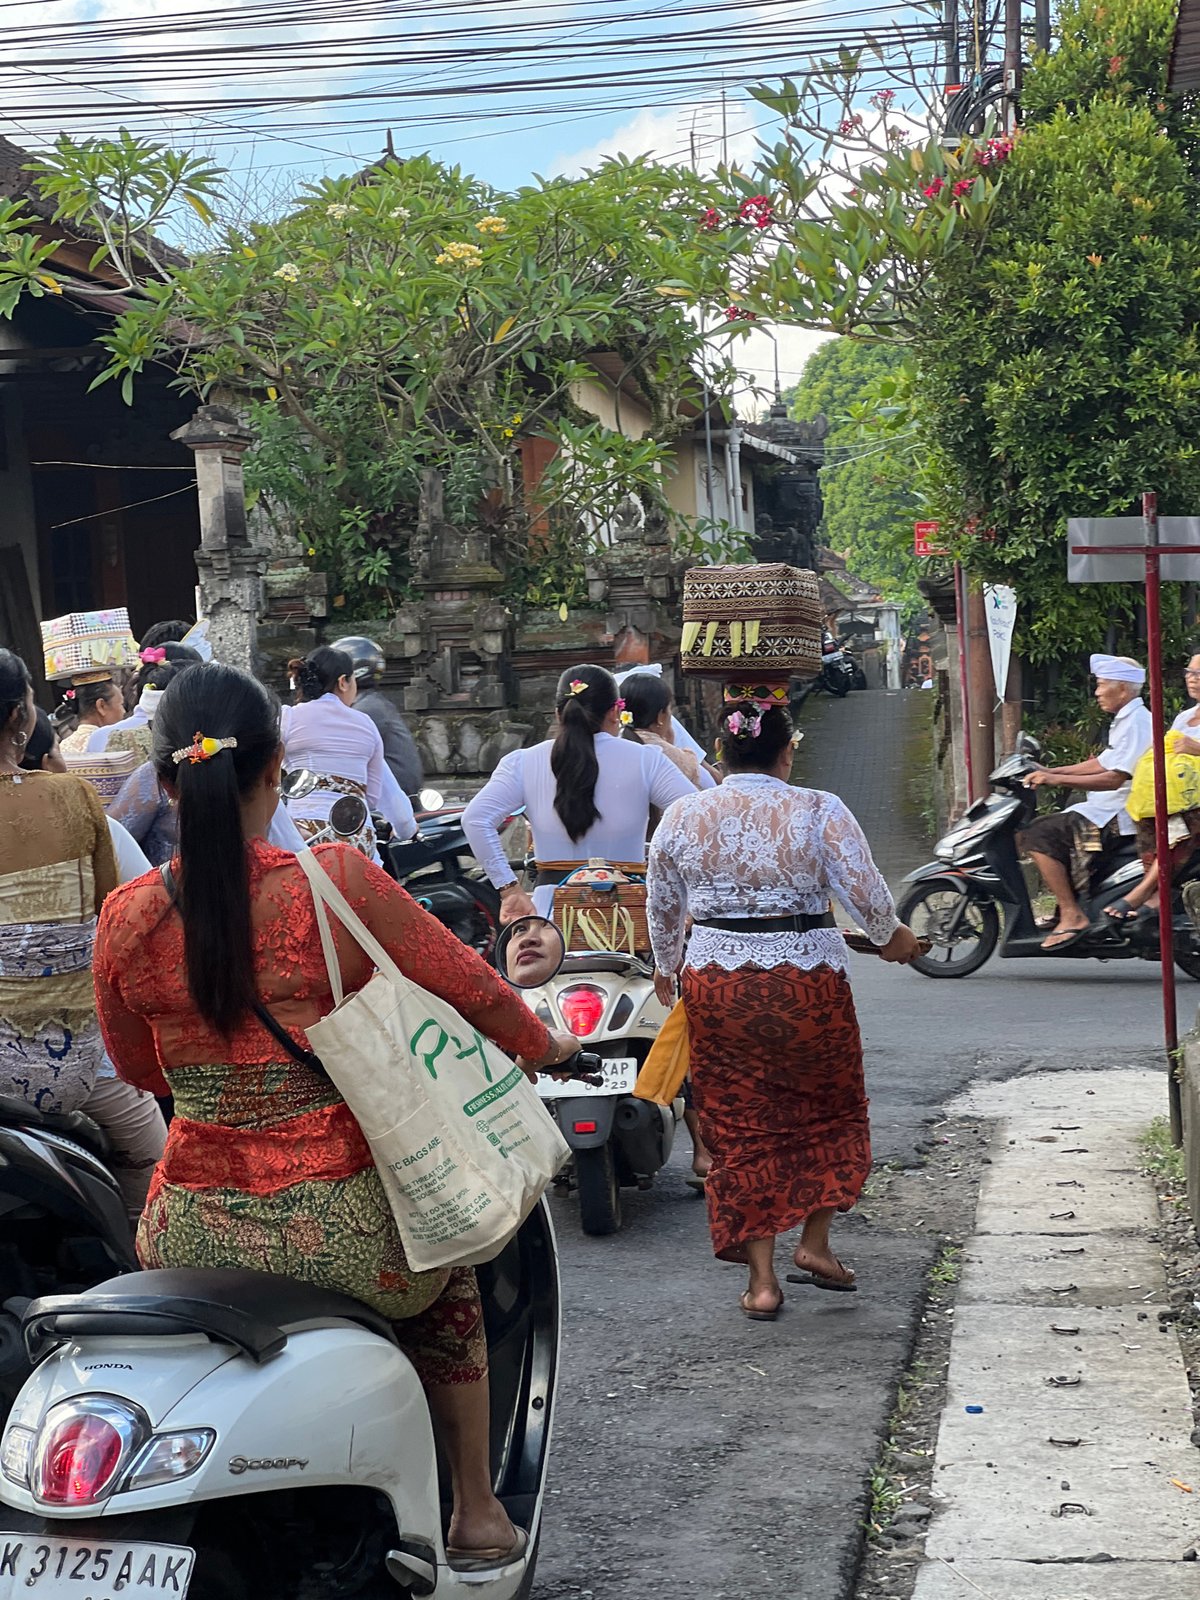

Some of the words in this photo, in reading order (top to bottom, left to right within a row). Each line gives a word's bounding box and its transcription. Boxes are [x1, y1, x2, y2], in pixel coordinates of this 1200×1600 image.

[402, 1147, 429, 1167] BAGS
[412, 1170, 436, 1189] THREAT
[435, 1164, 444, 1174] TO
[429, 1206, 440, 1215] DO
[440, 1195, 456, 1210] THEY
[429, 1212, 446, 1226] PARK
[446, 1204, 460, 1217] AND
[447, 1214, 459, 1223] BUT
[459, 1204, 474, 1218] THEY
[473, 1191, 488, 1205] CAN
[439, 1227, 451, 1236] UP
[450, 1222, 459, 1232] TO
[472, 1198, 492, 1217] YEARS
[427, 1237, 437, 1246] TO
[437, 1231, 460, 1243] BREAK
[84, 1363, 133, 1371] HONDA
[30, 1544, 113, 1581] 3125
[114, 1551, 187, 1592] AAK
